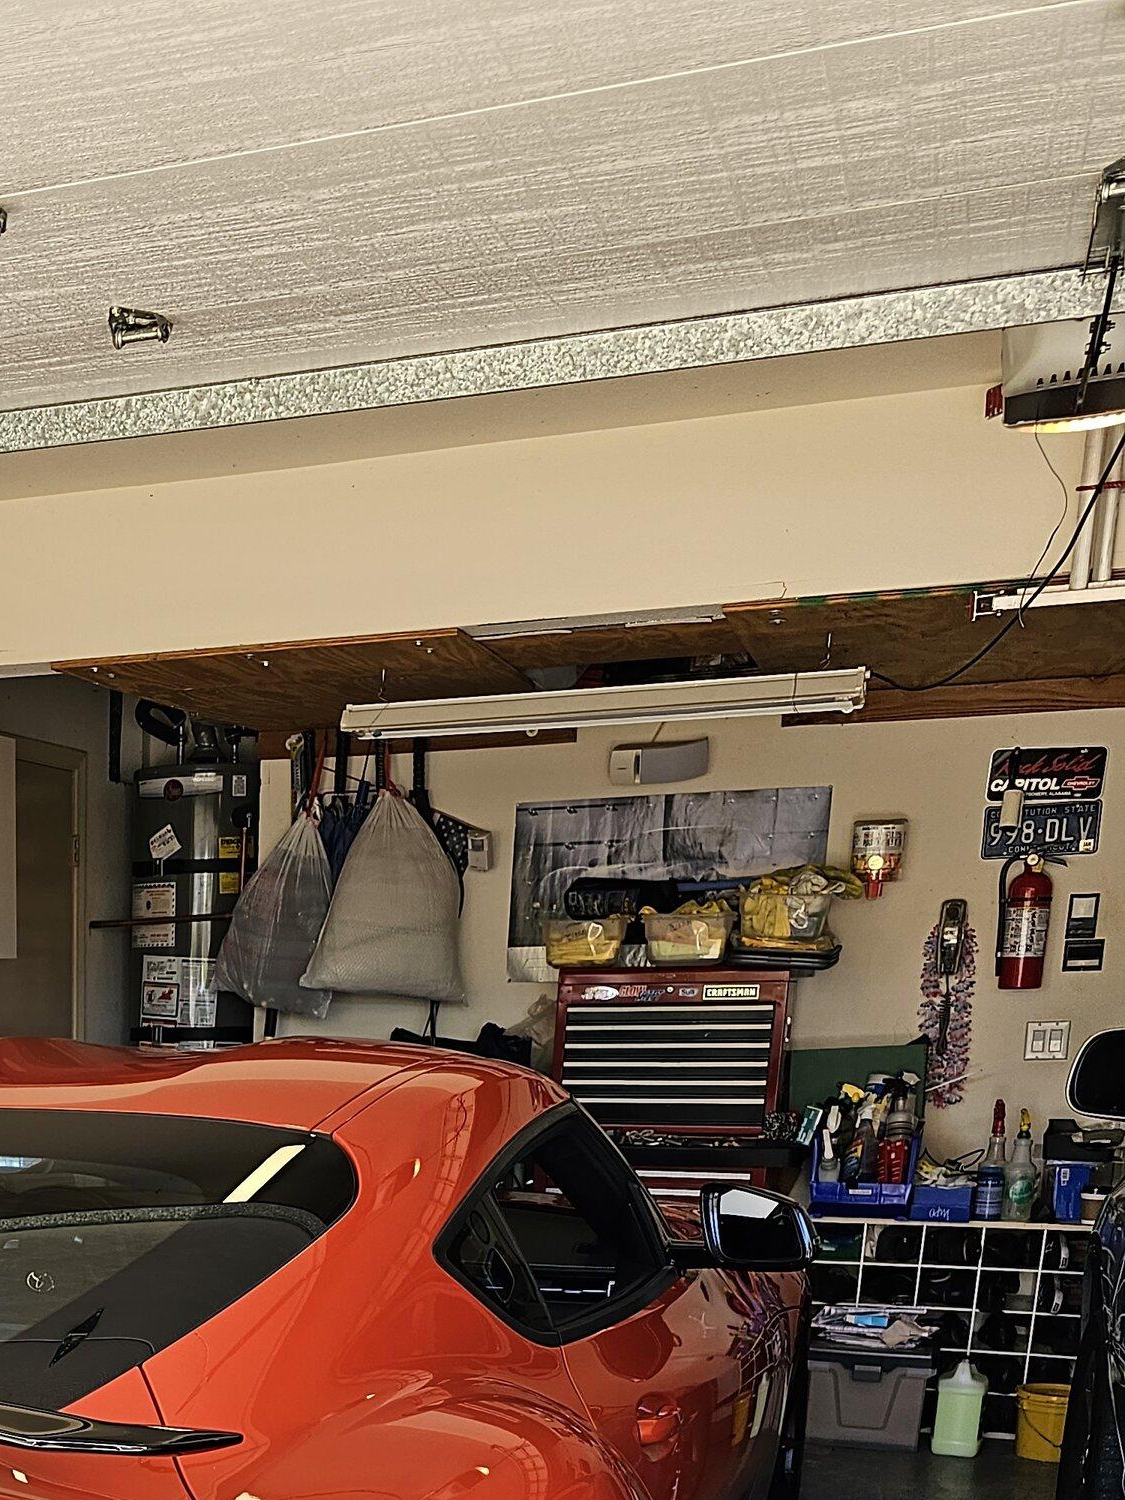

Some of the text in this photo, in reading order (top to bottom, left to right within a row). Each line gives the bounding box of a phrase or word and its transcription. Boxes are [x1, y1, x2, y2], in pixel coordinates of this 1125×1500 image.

[992, 753, 1102, 778] Rck Solid
[990, 804, 1095, 818] CTUTION STATE
[706, 987, 756, 997] CRAFTSMAN
